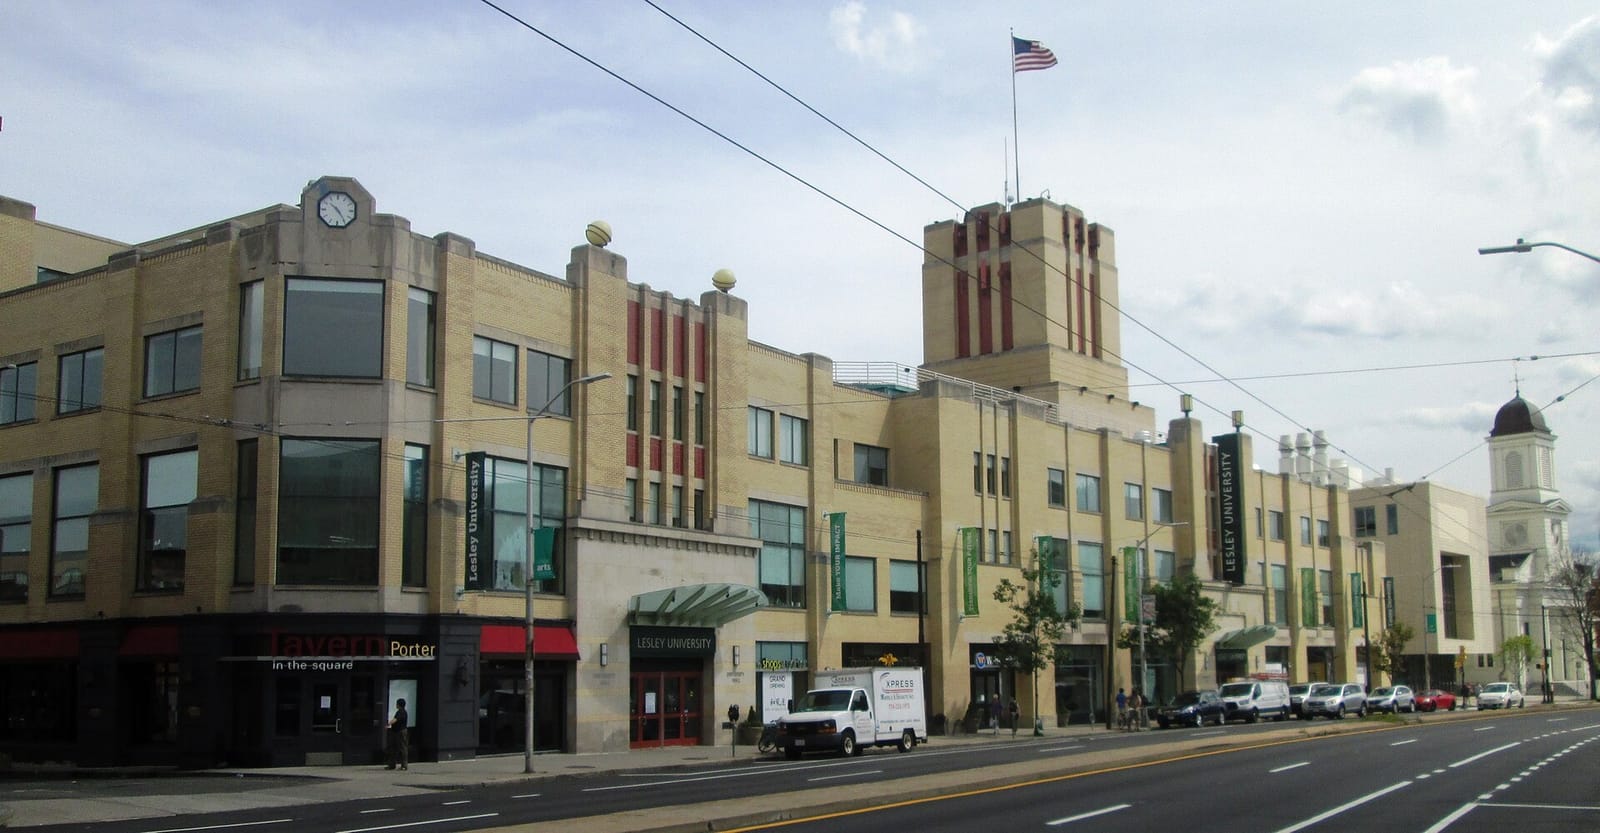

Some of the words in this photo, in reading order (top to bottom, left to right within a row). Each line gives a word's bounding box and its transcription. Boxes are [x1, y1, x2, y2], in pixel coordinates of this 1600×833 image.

[469, 461, 481, 533] University
[1221, 452, 1234, 524] UNIVERSITY
[469, 535, 480, 582] Lesley
[537, 564, 552, 572] arts
[1225, 529, 1236, 572] LESLEY
[258, 627, 386, 658] Tavern
[391, 641, 437, 657] Porter
[637, 637, 665, 649] LESLEY
[667, 637, 712, 649] UNIVERSITY
[273, 660, 284, 670] in
[287, 660, 308, 670] the
[312, 661, 354, 672] square
